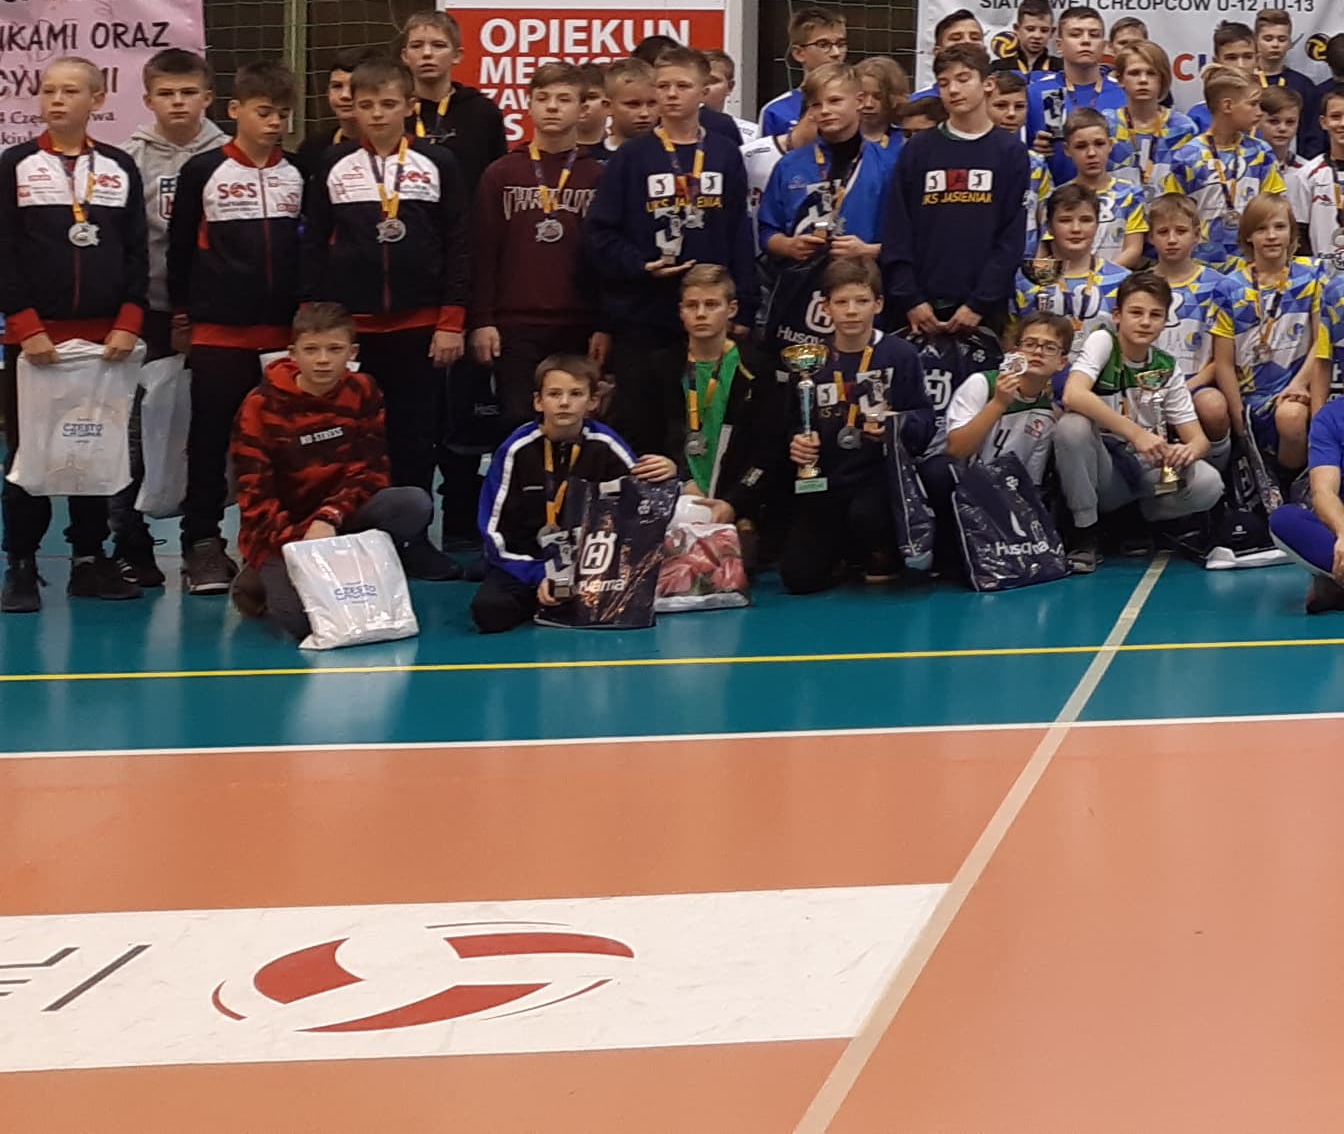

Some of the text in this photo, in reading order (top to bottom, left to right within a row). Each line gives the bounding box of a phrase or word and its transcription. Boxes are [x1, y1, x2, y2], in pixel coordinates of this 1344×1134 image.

[90, 21, 171, 49] ORAZ
[479, 18, 691, 54] OPIEKUN
[313, 427, 344, 443] STRESS
